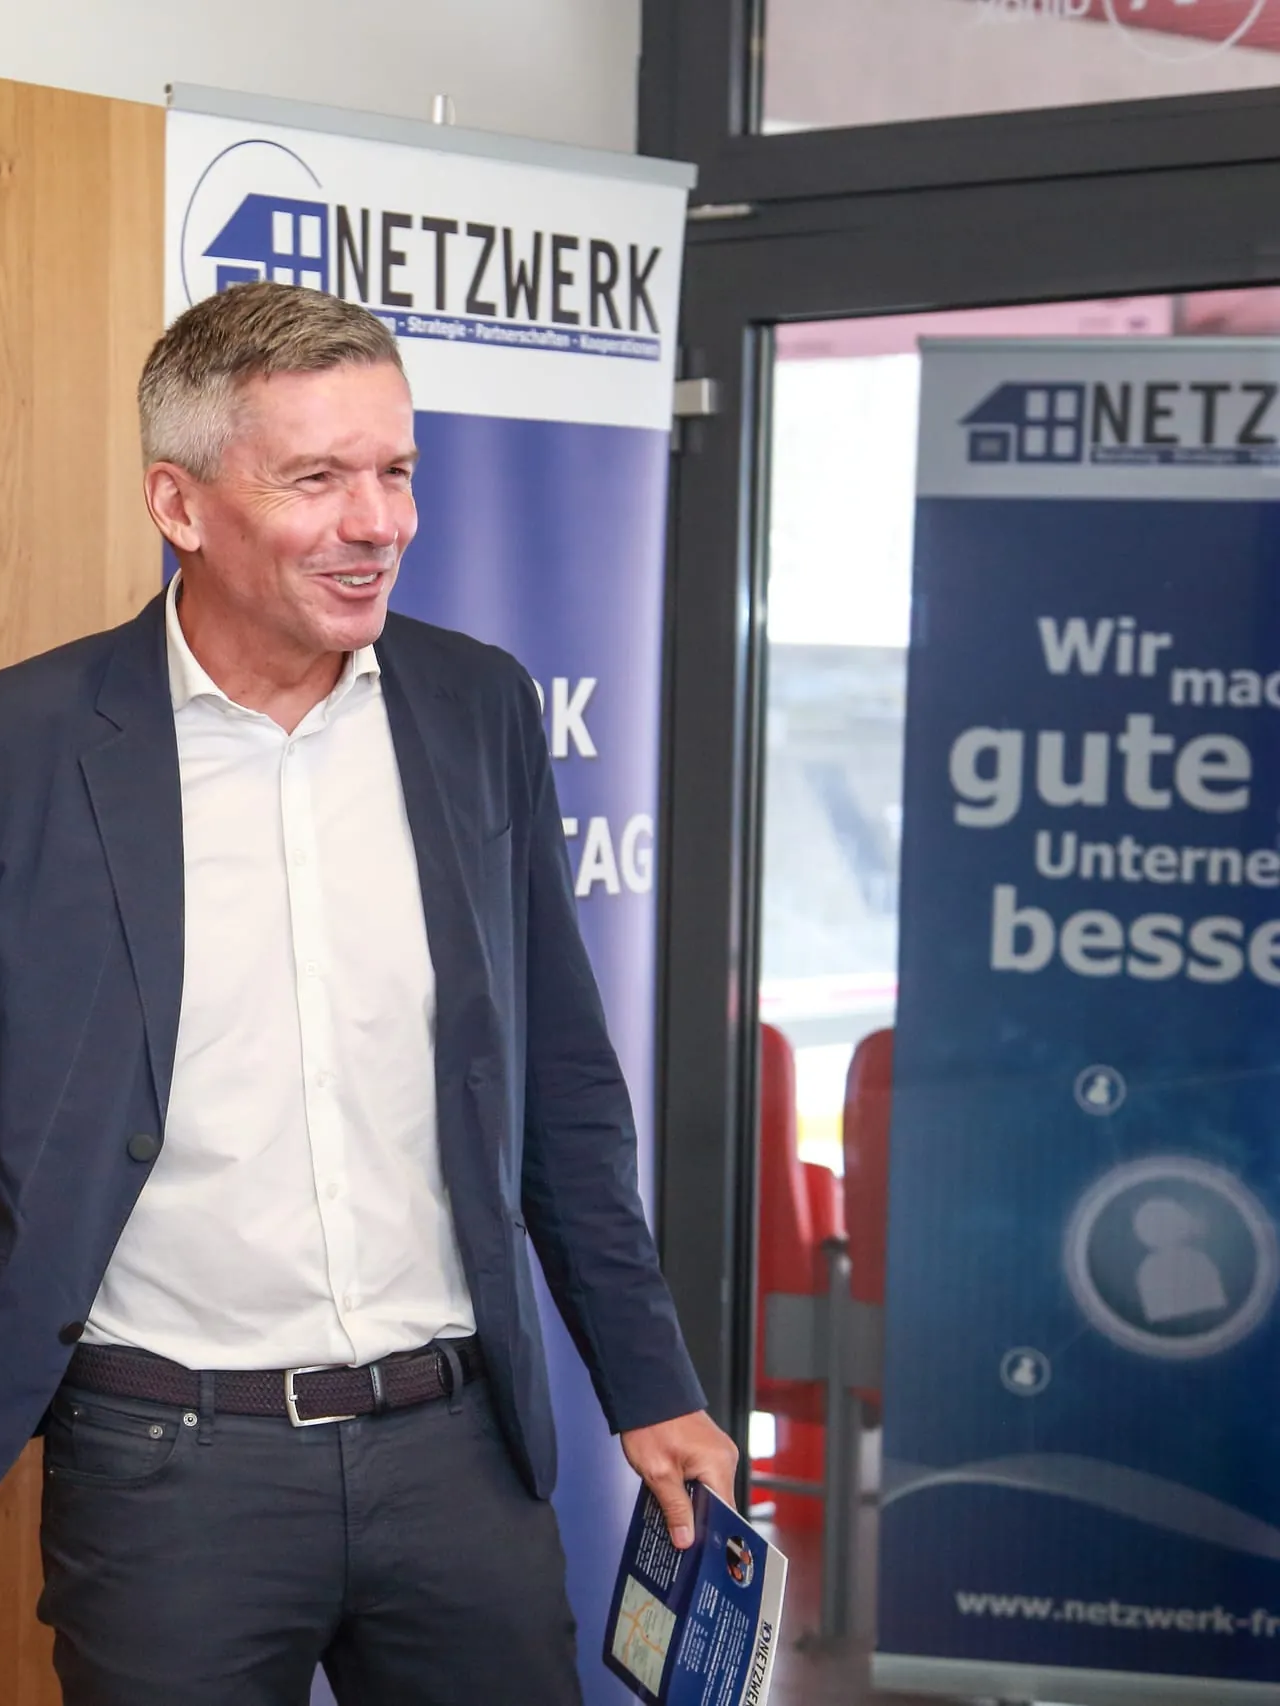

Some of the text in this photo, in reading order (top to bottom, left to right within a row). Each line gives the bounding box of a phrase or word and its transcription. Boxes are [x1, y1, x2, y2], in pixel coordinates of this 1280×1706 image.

[335, 204, 662, 333] NETZWERK
[1091, 381, 1280, 446] NETZ
[1036, 616, 1174, 677] Wir
[949, 713, 1253, 829] gute
